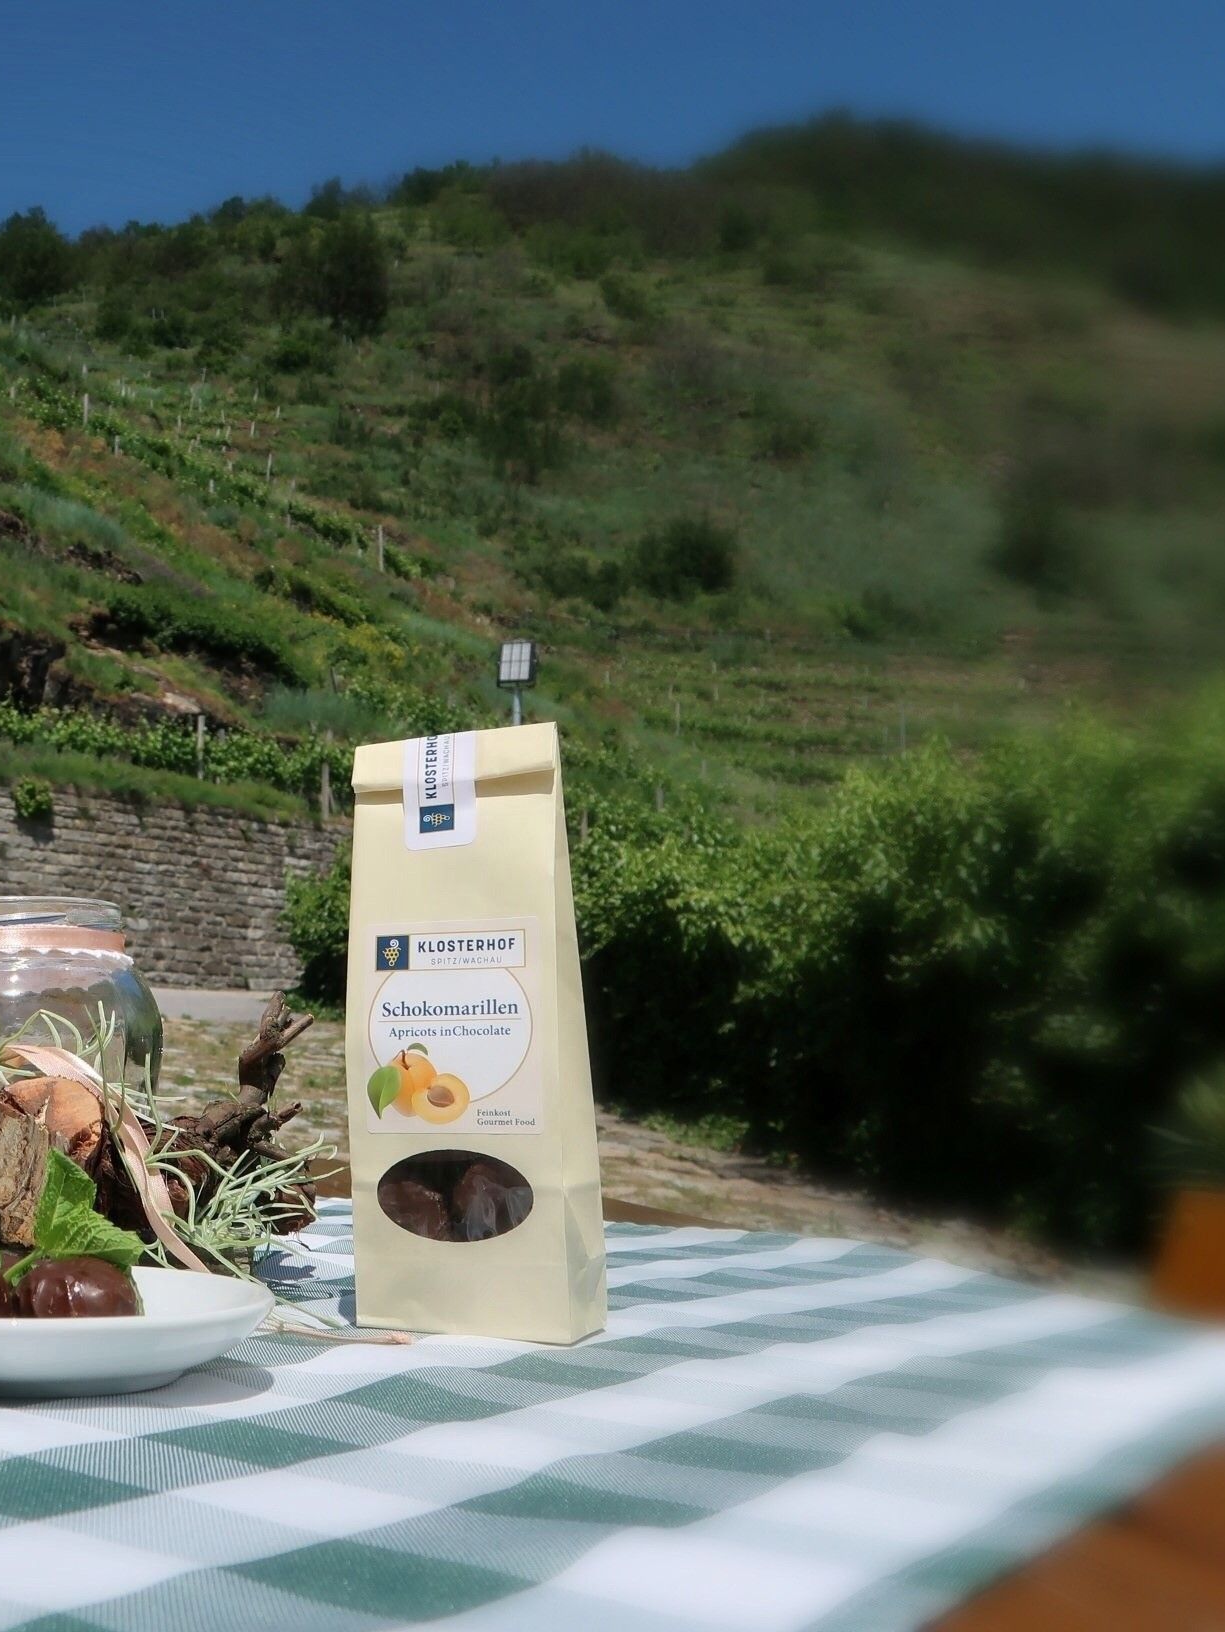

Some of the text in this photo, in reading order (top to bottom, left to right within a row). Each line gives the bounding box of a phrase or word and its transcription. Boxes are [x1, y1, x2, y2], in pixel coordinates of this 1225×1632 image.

[418, 938, 515, 952] KLOSTERHOF
[431, 956, 502, 965] SPITZ/WACHAU
[382, 999, 518, 1017] Schokomarillen
[389, 1027, 437, 1040] Apricots
[477, 1108, 511, 1117] Feinkost
[477, 1118, 536, 1127] Gourmet Food
